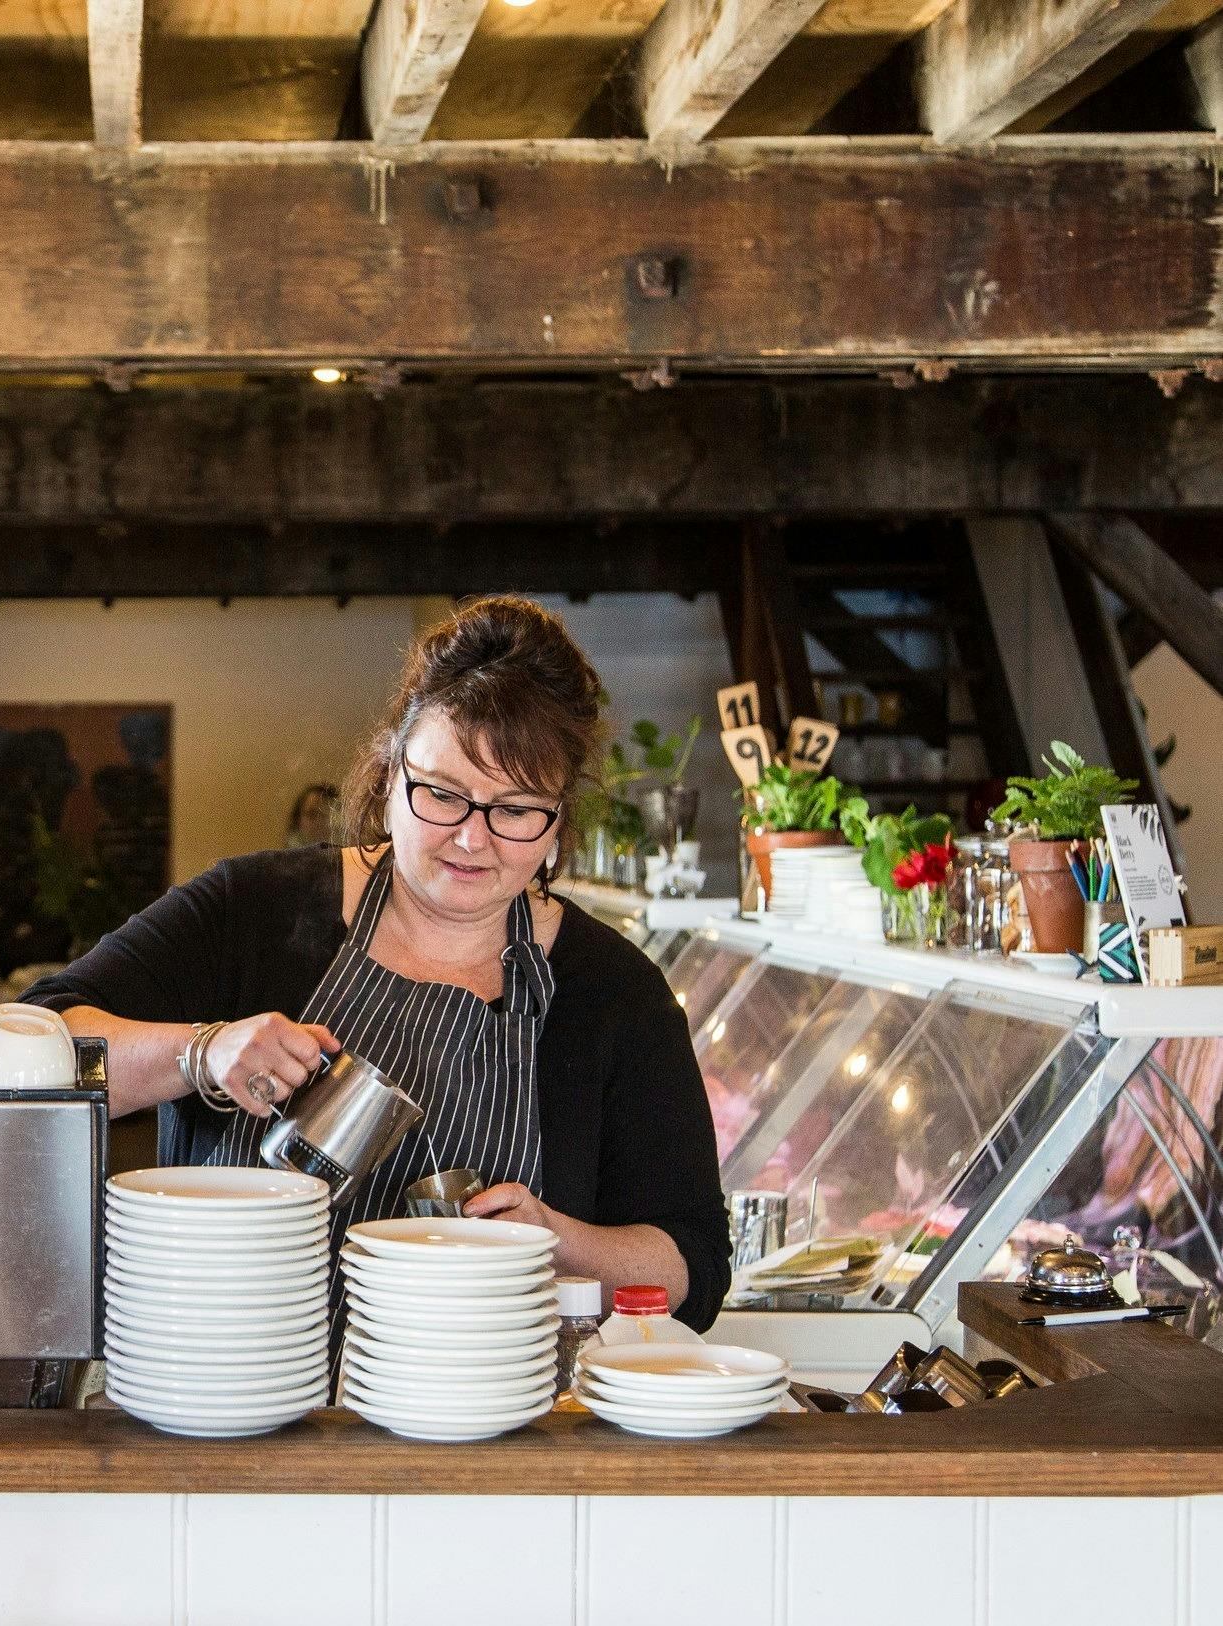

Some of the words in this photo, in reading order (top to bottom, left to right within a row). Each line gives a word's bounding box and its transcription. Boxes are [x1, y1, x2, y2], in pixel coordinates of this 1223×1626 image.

[726, 693, 754, 728] 11
[737, 738, 764, 780] 9
[793, 729, 829, 764] 12
